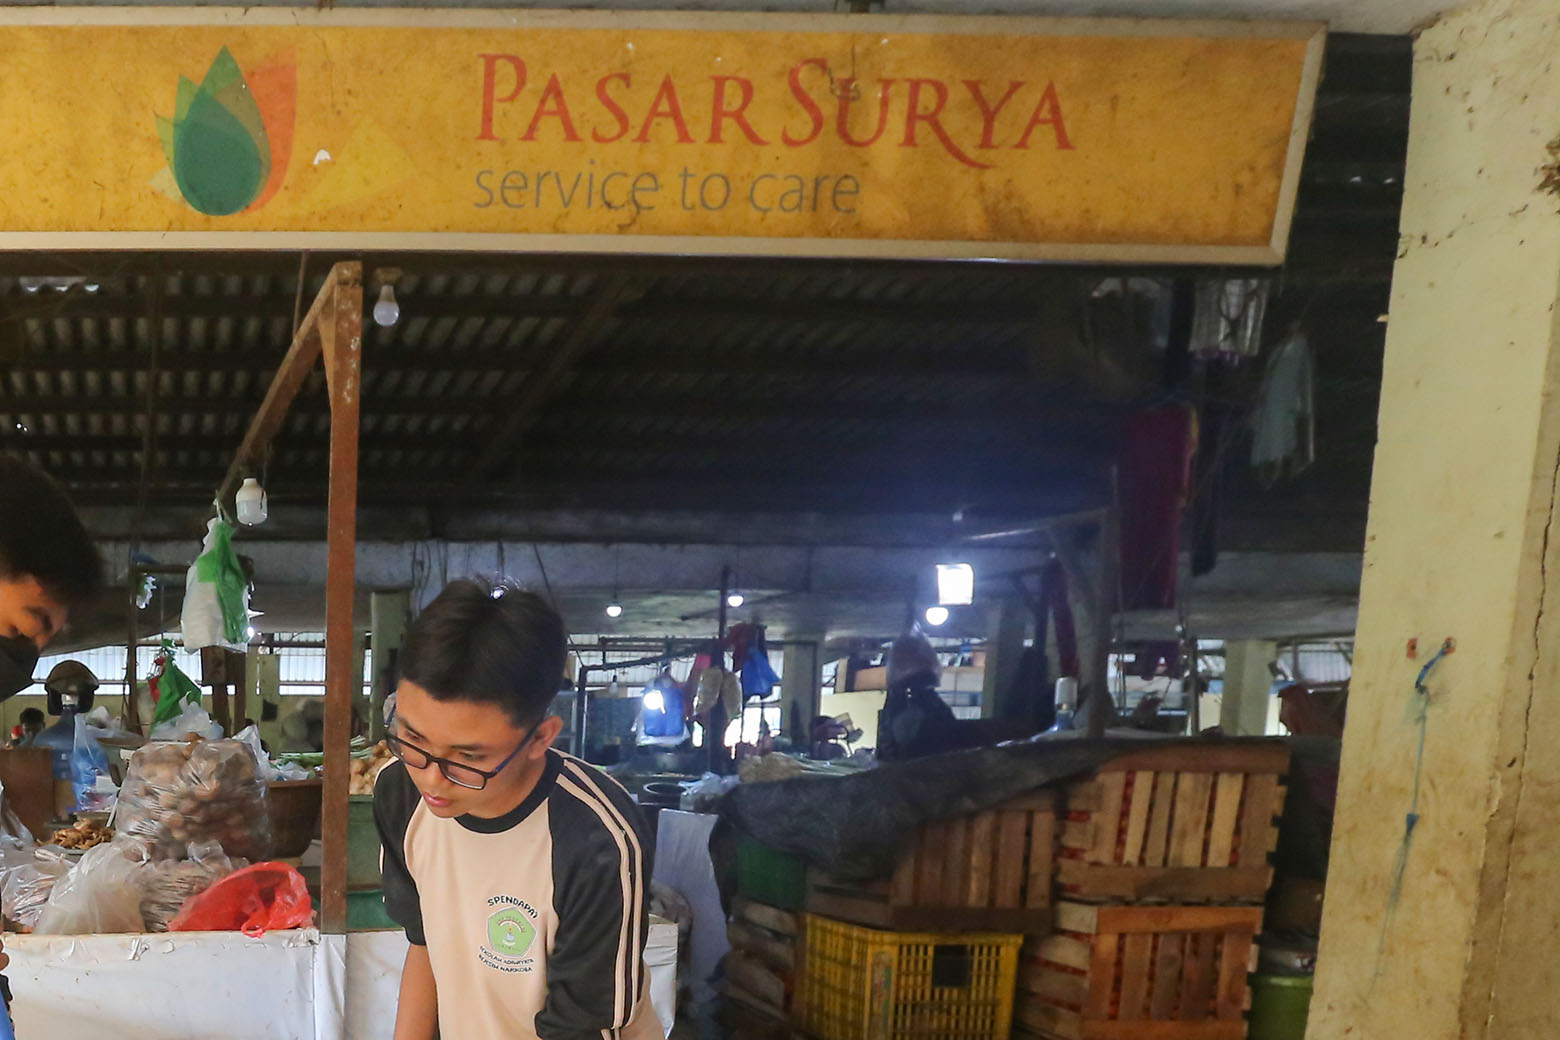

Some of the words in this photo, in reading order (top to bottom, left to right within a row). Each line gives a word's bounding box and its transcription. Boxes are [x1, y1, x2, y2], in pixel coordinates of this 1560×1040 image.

[473, 158, 660, 212] service
[679, 166, 732, 212] to
[748, 171, 862, 215] care
